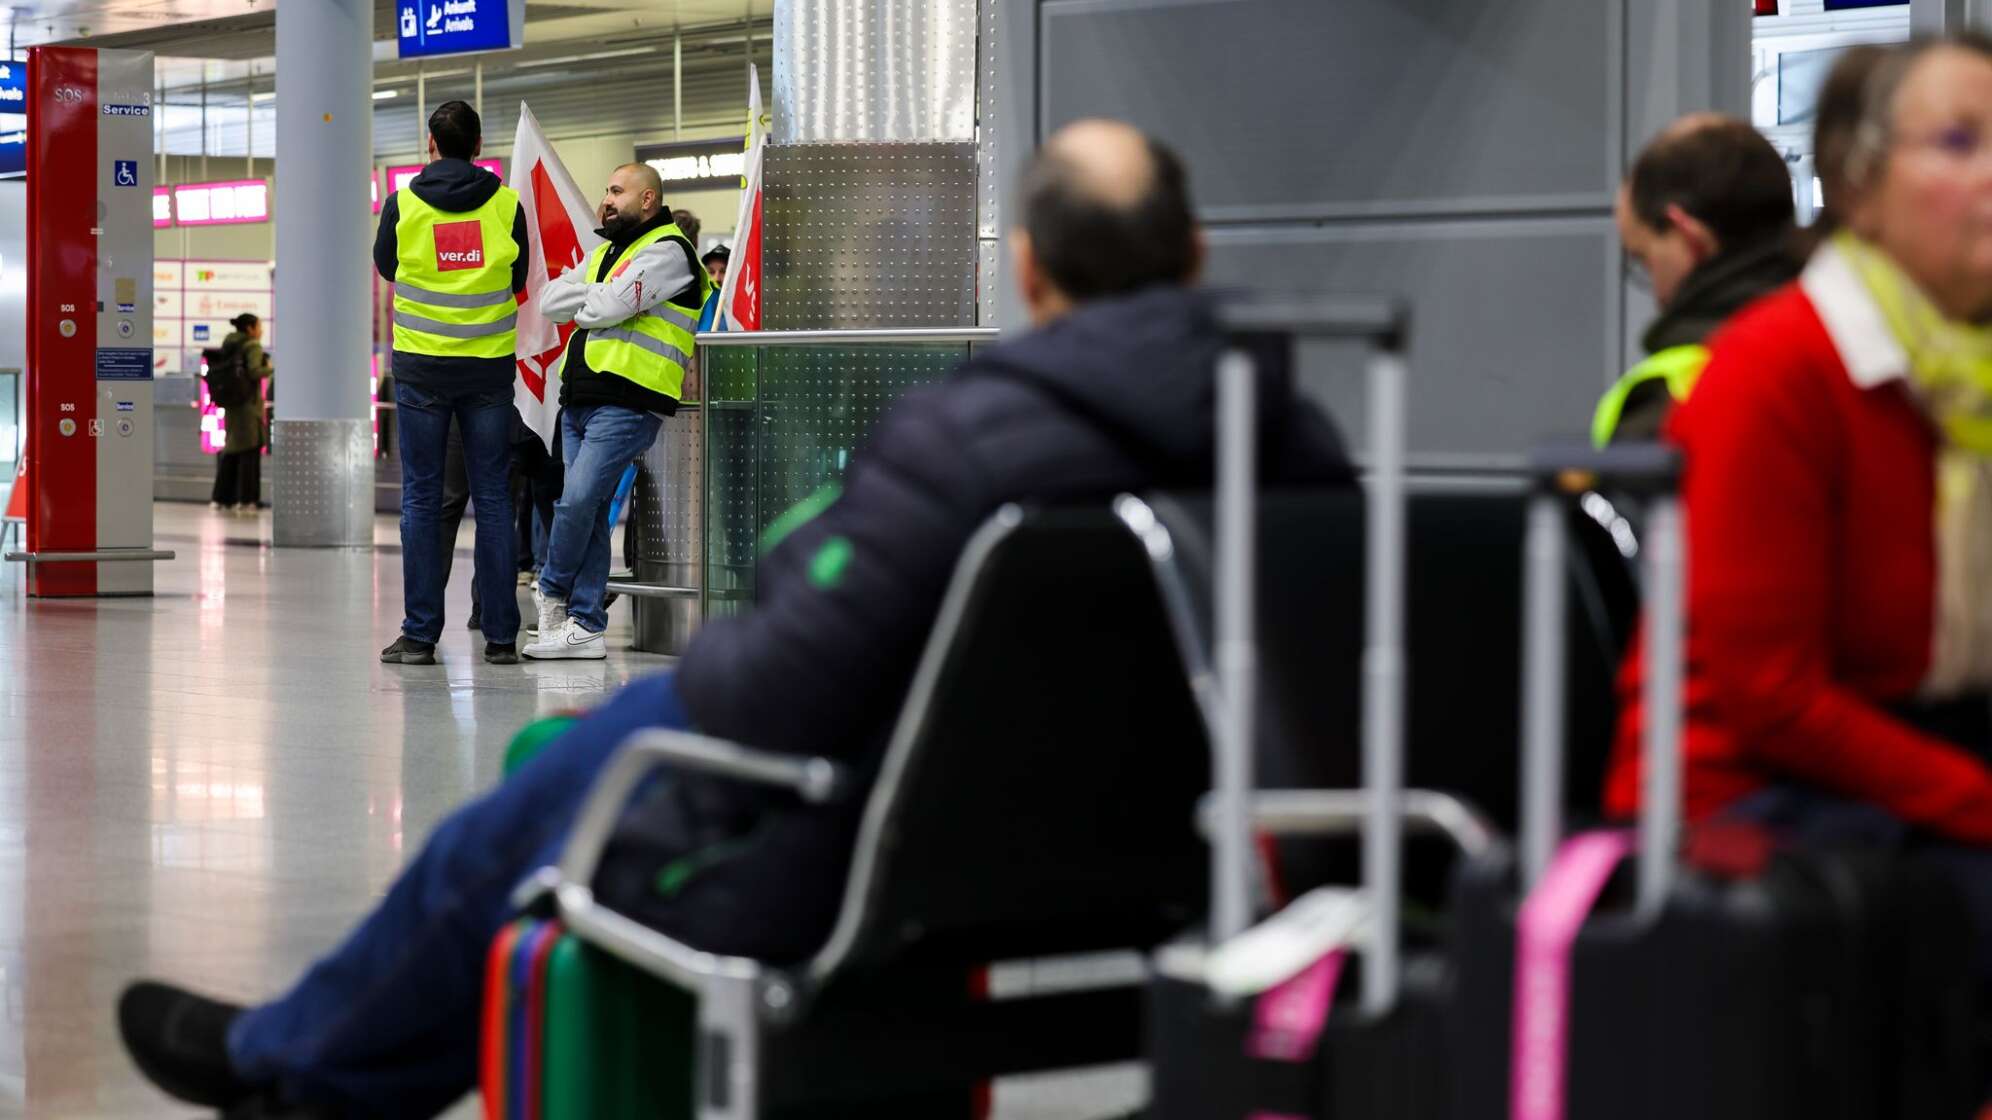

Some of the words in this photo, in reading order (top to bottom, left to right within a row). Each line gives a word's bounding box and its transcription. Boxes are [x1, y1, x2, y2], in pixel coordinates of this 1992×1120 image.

[445, 16, 474, 32] Arrivals
[55, 88, 82, 103] SOS
[103, 104, 149, 116] Service
[439, 249, 481, 262] ver.di
[61, 304, 75, 312] SOS
[61, 403, 75, 411] SOS
